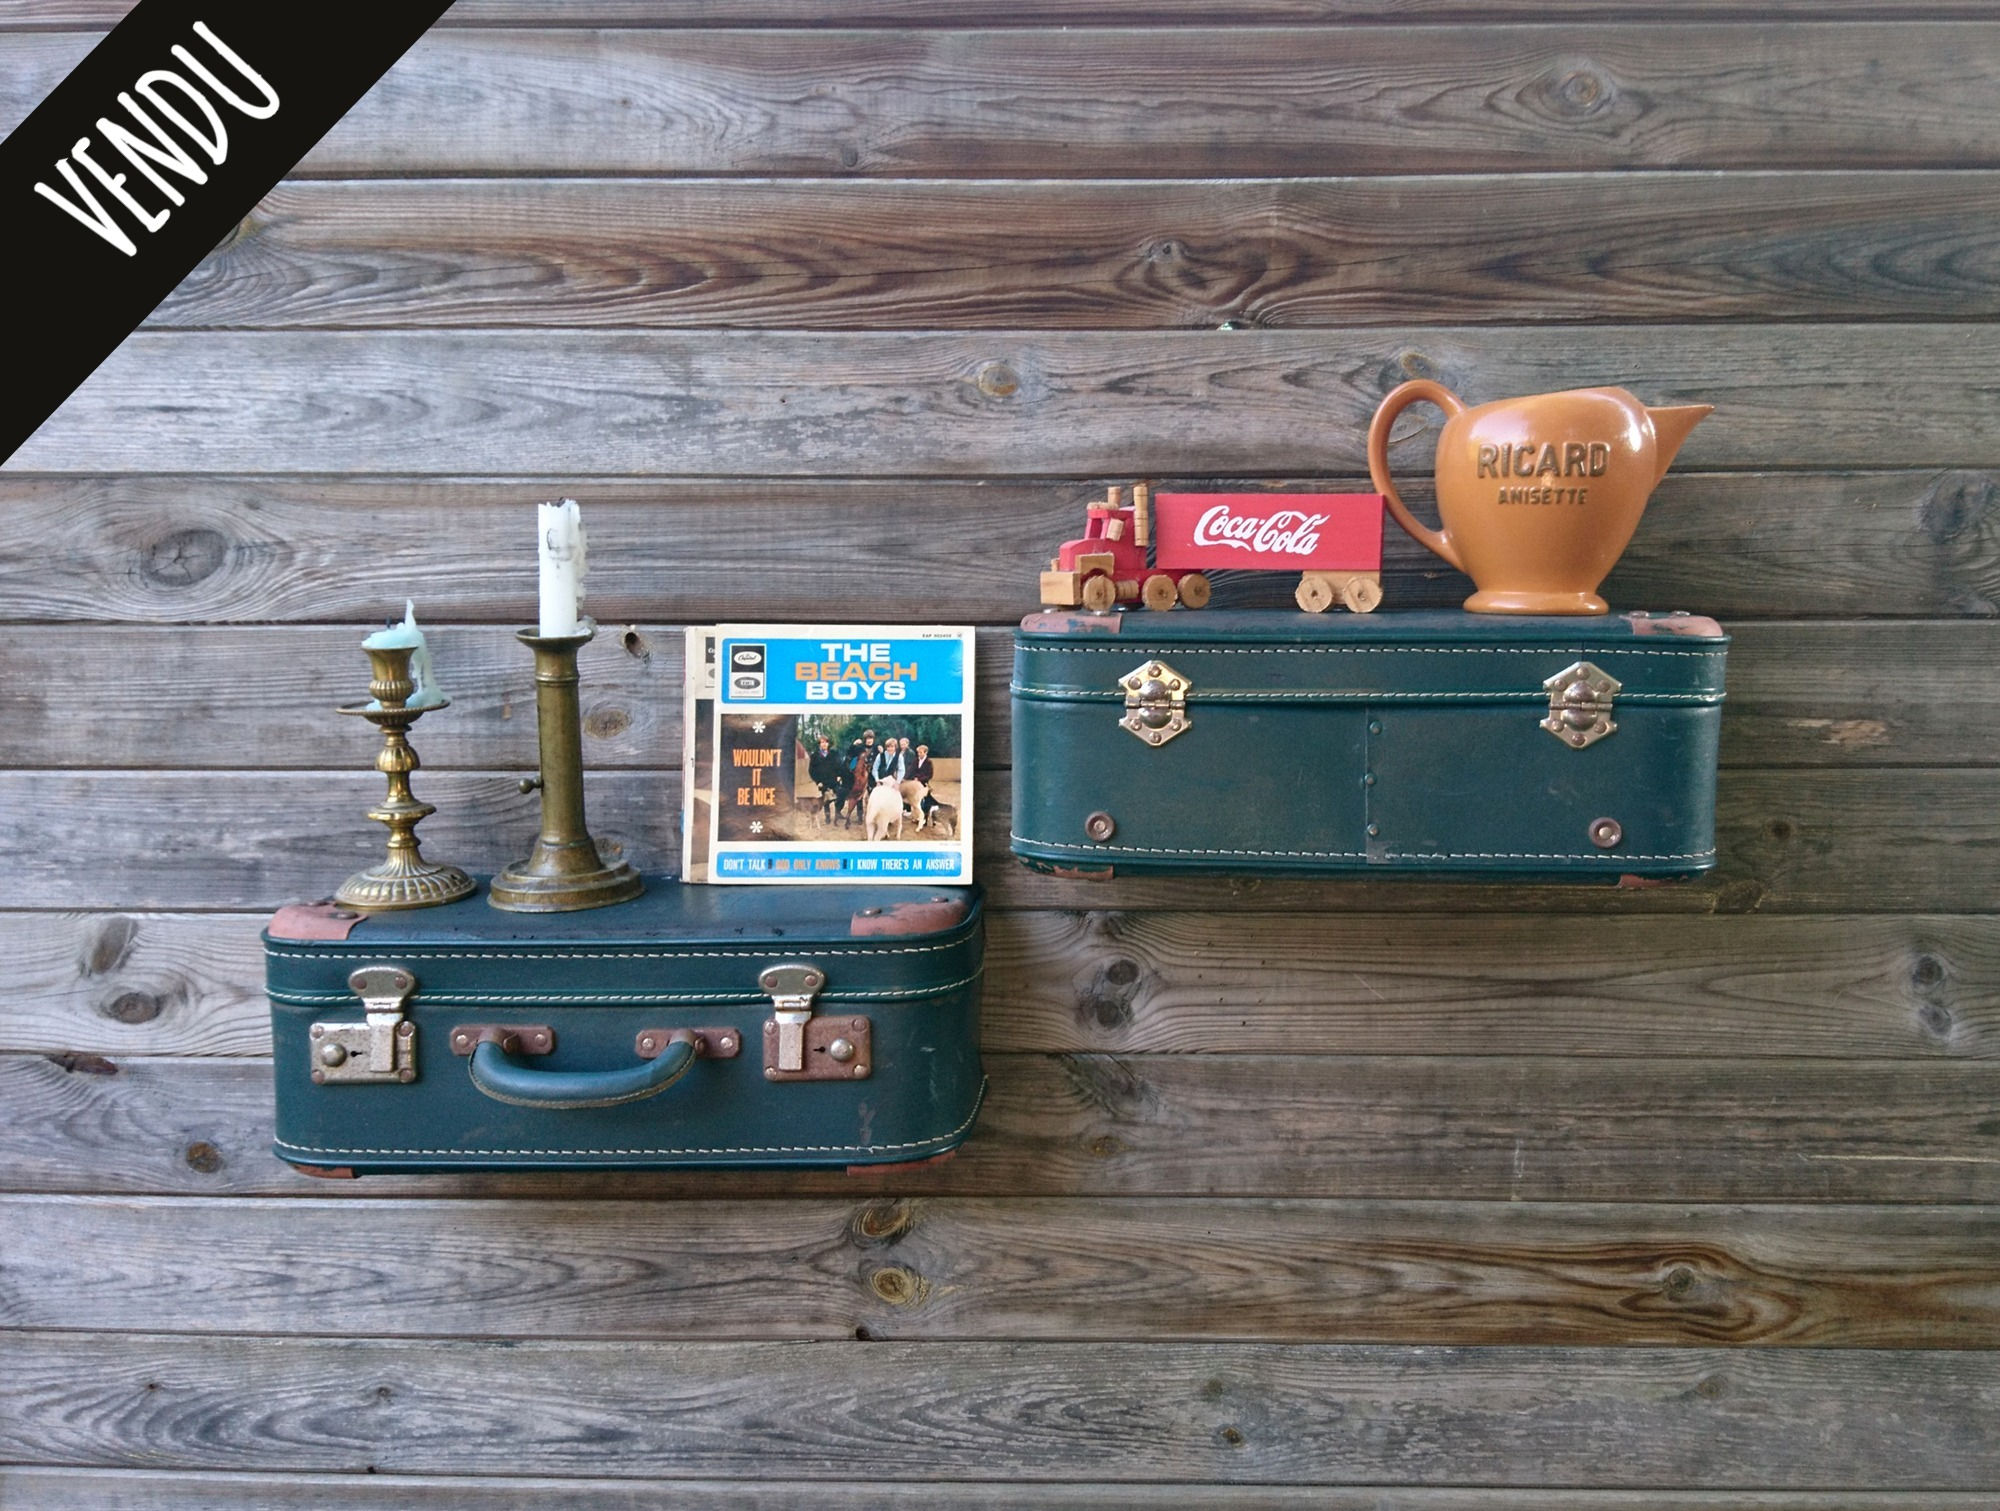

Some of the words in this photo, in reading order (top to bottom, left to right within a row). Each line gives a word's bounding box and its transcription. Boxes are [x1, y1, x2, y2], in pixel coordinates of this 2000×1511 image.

[1477, 441, 1611, 478] RICARD
[1498, 486, 1588, 505] ANISETTE
[1193, 505, 1331, 555] Coca-Cola
[820, 643, 890, 662] THE
[795, 662, 918, 681] BEACH
[806, 681, 906, 700] BOYS
[733, 749, 782, 767] WOULDN'T
[752, 768, 762, 786] IT
[737, 788, 751, 805] BE
[753, 788, 776, 805] NICE
[723, 858, 744, 870] DON'T
[748, 858, 766, 870] TALK
[857, 858, 878, 870] KNOW
[881, 858, 909, 870] THERE'S
[912, 858, 923, 870] AN
[926, 858, 955, 870] ANSWER
